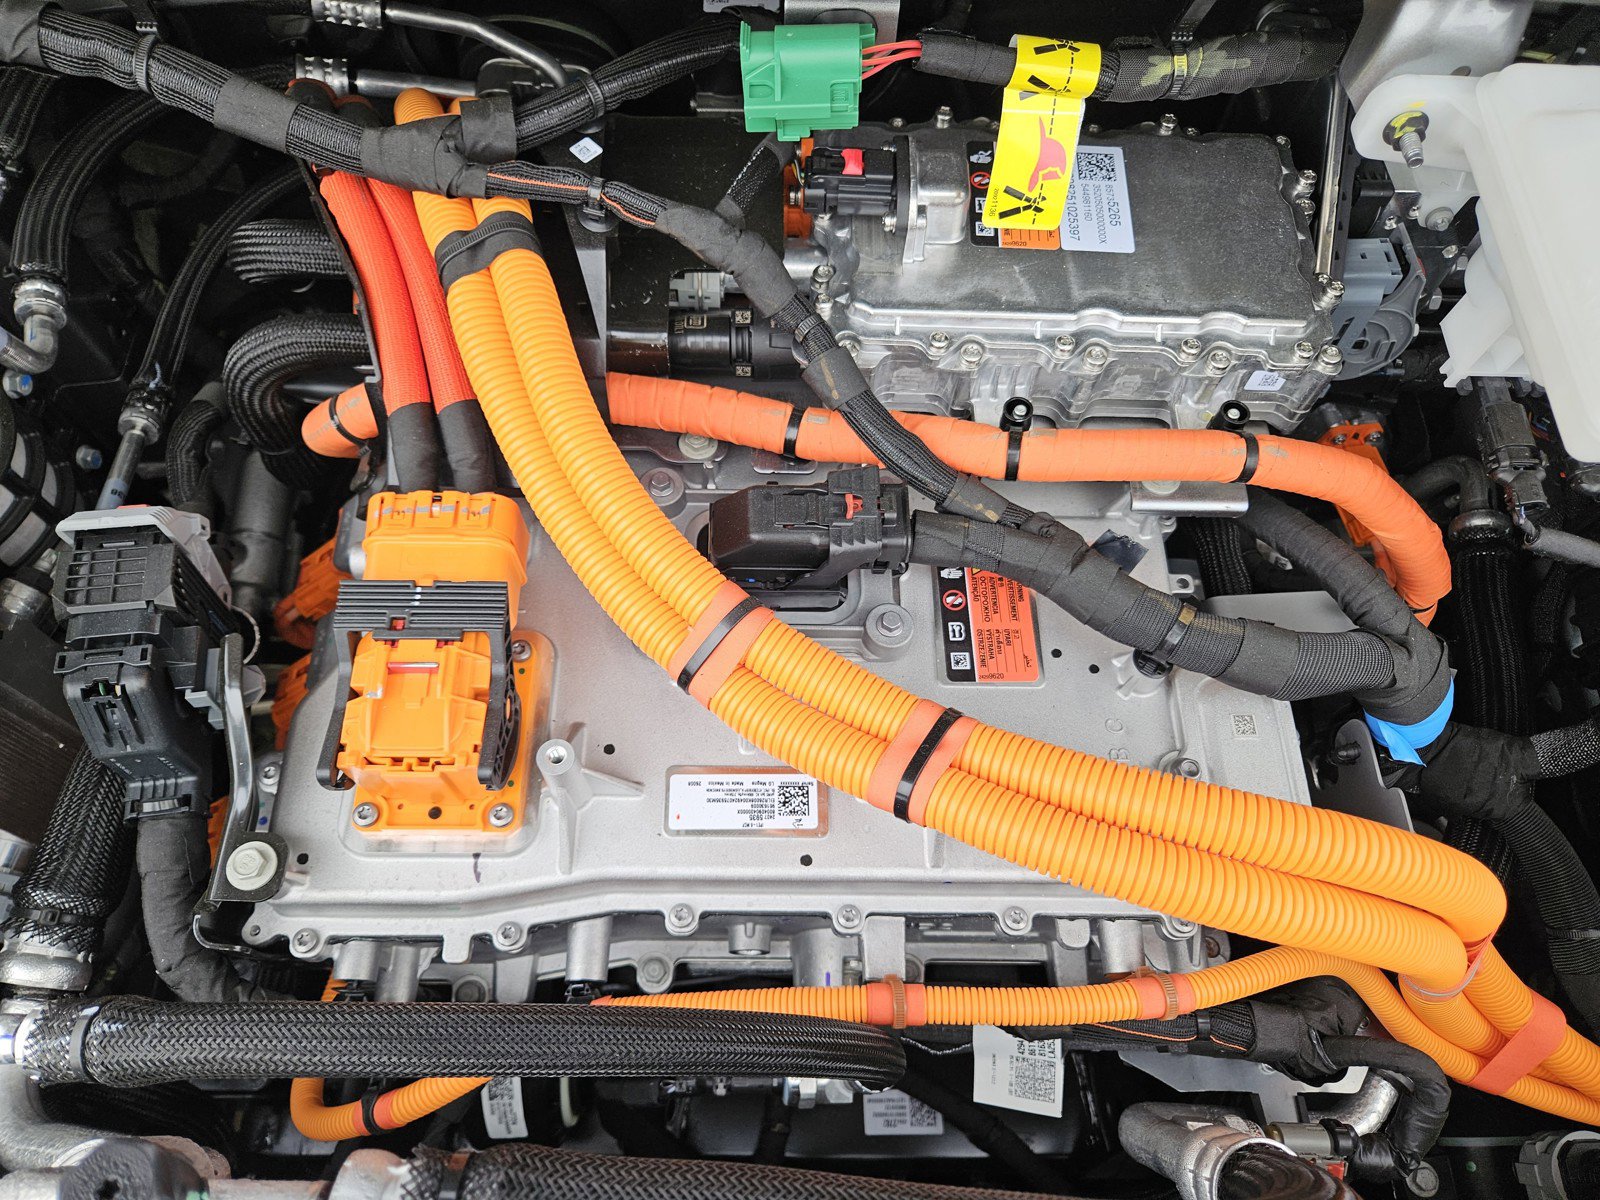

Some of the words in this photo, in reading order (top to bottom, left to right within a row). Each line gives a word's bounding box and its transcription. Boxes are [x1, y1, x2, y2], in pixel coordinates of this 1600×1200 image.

[1081, 183, 1093, 222] 544981160
[1104, 184, 1121, 227] 85735265
[970, 576, 981, 602] ATENÇÃO
[980, 576, 991, 623] ОСТОРОЖНО
[989, 576, 999, 615] ADVERTENCIA
[1007, 578, 1017, 621] VERTISSEMENT
[1004, 629, 1012, 647] UYARI
